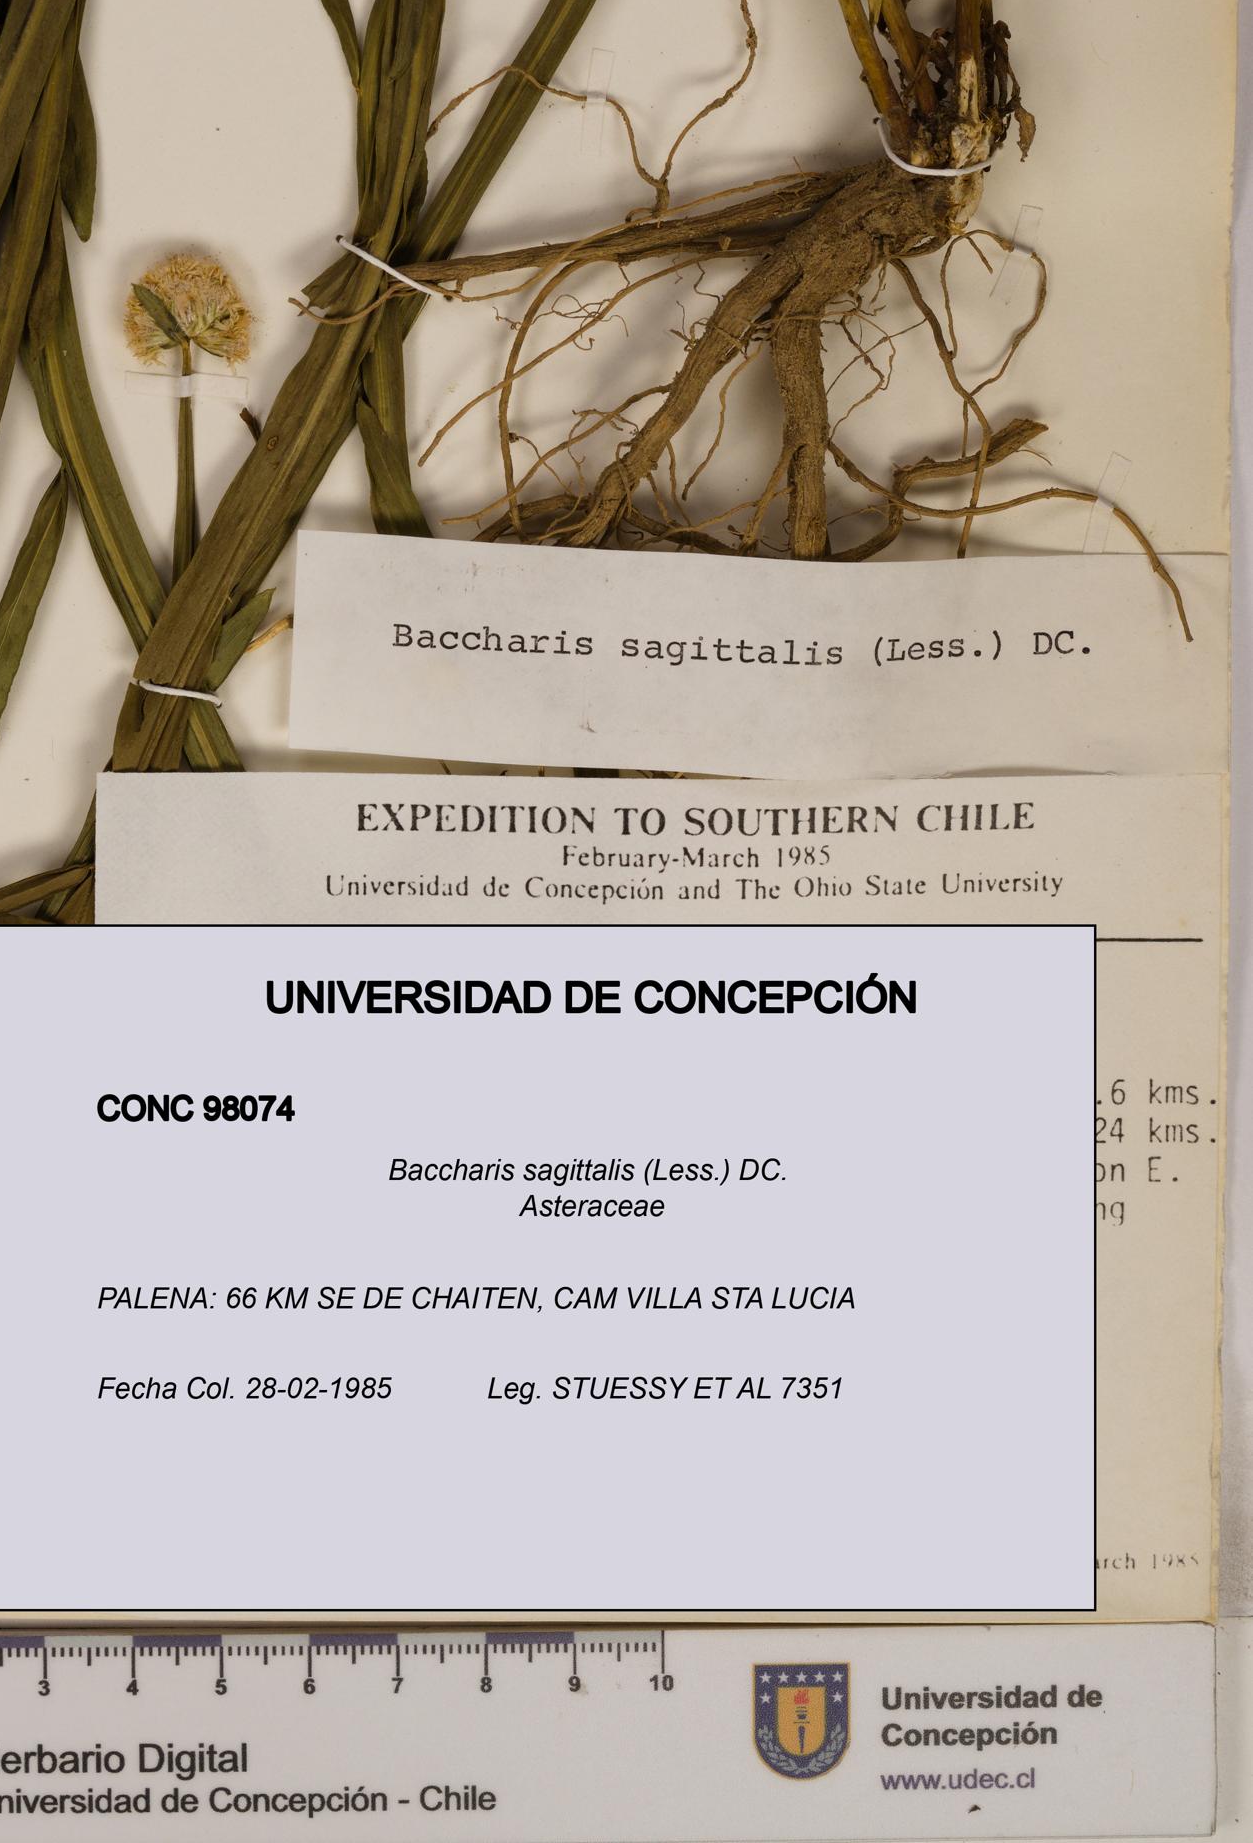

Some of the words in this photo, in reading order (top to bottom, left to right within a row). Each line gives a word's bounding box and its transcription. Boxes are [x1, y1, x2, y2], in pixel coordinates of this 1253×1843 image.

[393, 624, 592, 655] Baccharis
[622, 636, 842, 668] sagittalis
[875, 630, 1001, 666] (Less.)
[1033, 631, 1090, 655] DC.
[358, 804, 595, 834] EXPEDITION
[614, 808, 665, 836] TO
[685, 806, 898, 836] SOUTHERN
[917, 803, 1034, 832] CHILE
[563, 845, 759, 873] February-March
[778, 845, 829, 867] 1985
[327, 875, 468, 896] Universidad
[483, 876, 509, 897] de
[525, 875, 664, 905] Concepción
[679, 879, 720, 899] and
[736, 879, 780, 899] The
[794, 876, 851, 897] Ohio
[866, 875, 926, 895] State
[943, 871, 1062, 897] University
[1150, 1079, 1216, 1105] kms.
[1150, 1117, 1215, 1143] kms.
[1148, 1156, 1178, 1182] E.
[37, 1679, 51, 1697] 3
[126, 1679, 139, 1697] 4
[215, 1678, 228, 1696] 5
[303, 1678, 316, 1695] 6
[391, 1677, 404, 1694] 7
[480, 1676, 493, 1694] 8
[568, 1675, 581, 1693] 9
[649, 1675, 675, 1692] 10
[882, 1685, 1057, 1710] Universidad
[1067, 1684, 1102, 1708] de
[881, 1721, 1057, 1751] Concepción
[139, 1743, 247, 1781] Digital
[880, 1767, 1035, 1790] www.udec.cl
[161, 1788, 198, 1813] de
[209, 1786, 387, 1818] Concepción
[420, 1785, 496, 1811] Chile
